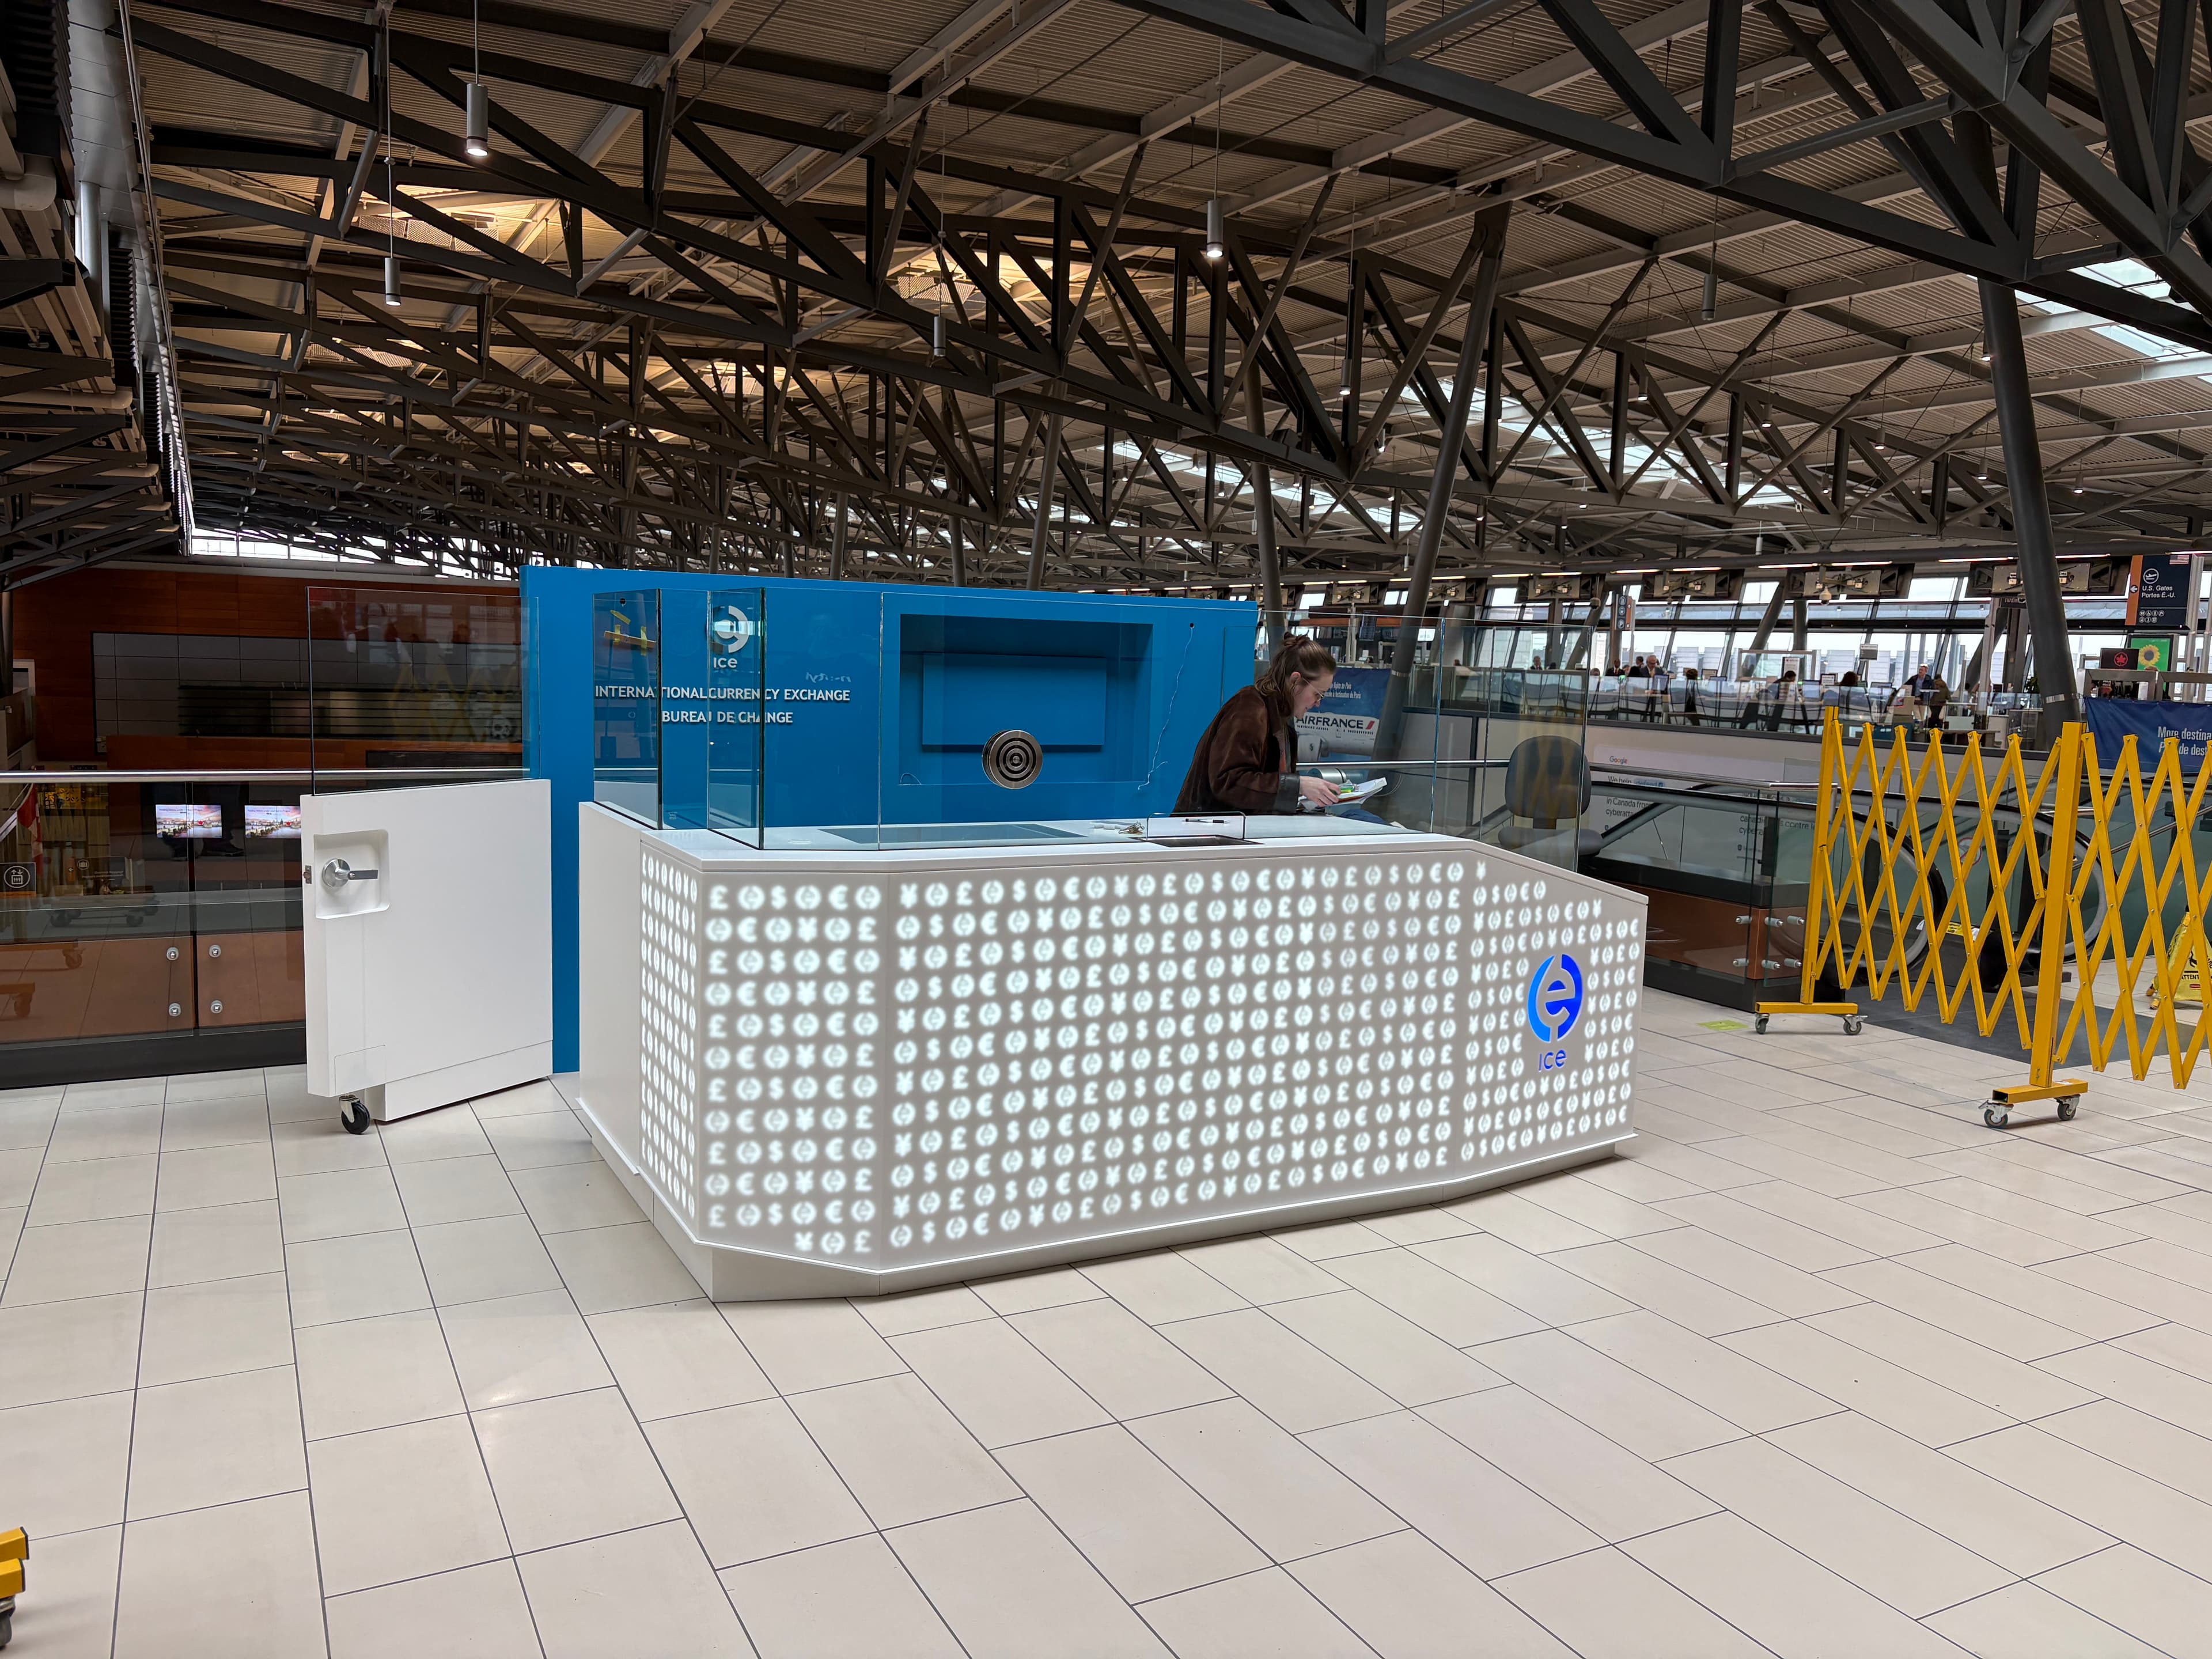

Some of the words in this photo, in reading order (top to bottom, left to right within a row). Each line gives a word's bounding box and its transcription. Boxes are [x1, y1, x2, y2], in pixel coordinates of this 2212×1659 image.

[713, 657, 737, 668] ice
[595, 685, 707, 699] INTERNATIONAL
[709, 688, 779, 700] CURRENCY
[784, 689, 850, 701] EXCHANGE
[717, 711, 734, 722] DE
[1297, 715, 1363, 729] AIRFRANCE
[2158, 726, 2179, 738] More
[2181, 728, 2212, 740] destina
[2179, 743, 2189, 755] de
[1609, 756, 1628, 764] Google
[1613, 798, 1635, 808] Canada
[1539, 1050, 1567, 1072] ice
